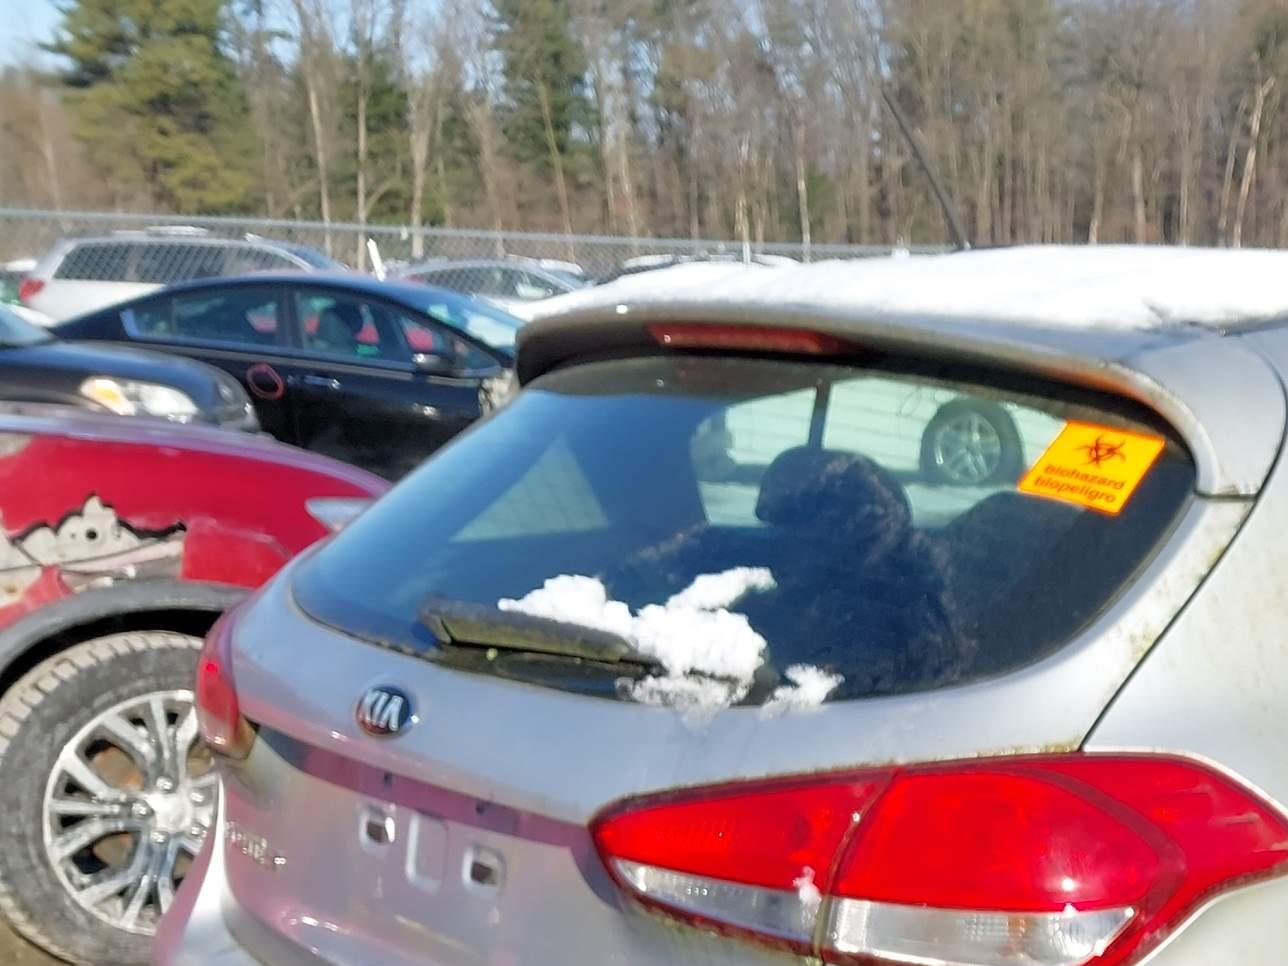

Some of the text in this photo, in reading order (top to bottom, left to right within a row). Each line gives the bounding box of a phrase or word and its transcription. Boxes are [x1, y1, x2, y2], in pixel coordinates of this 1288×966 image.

[1034, 475, 1117, 504] biopeligro
[1043, 463, 1126, 490] biohazard
[364, 690, 404, 732] KIA
